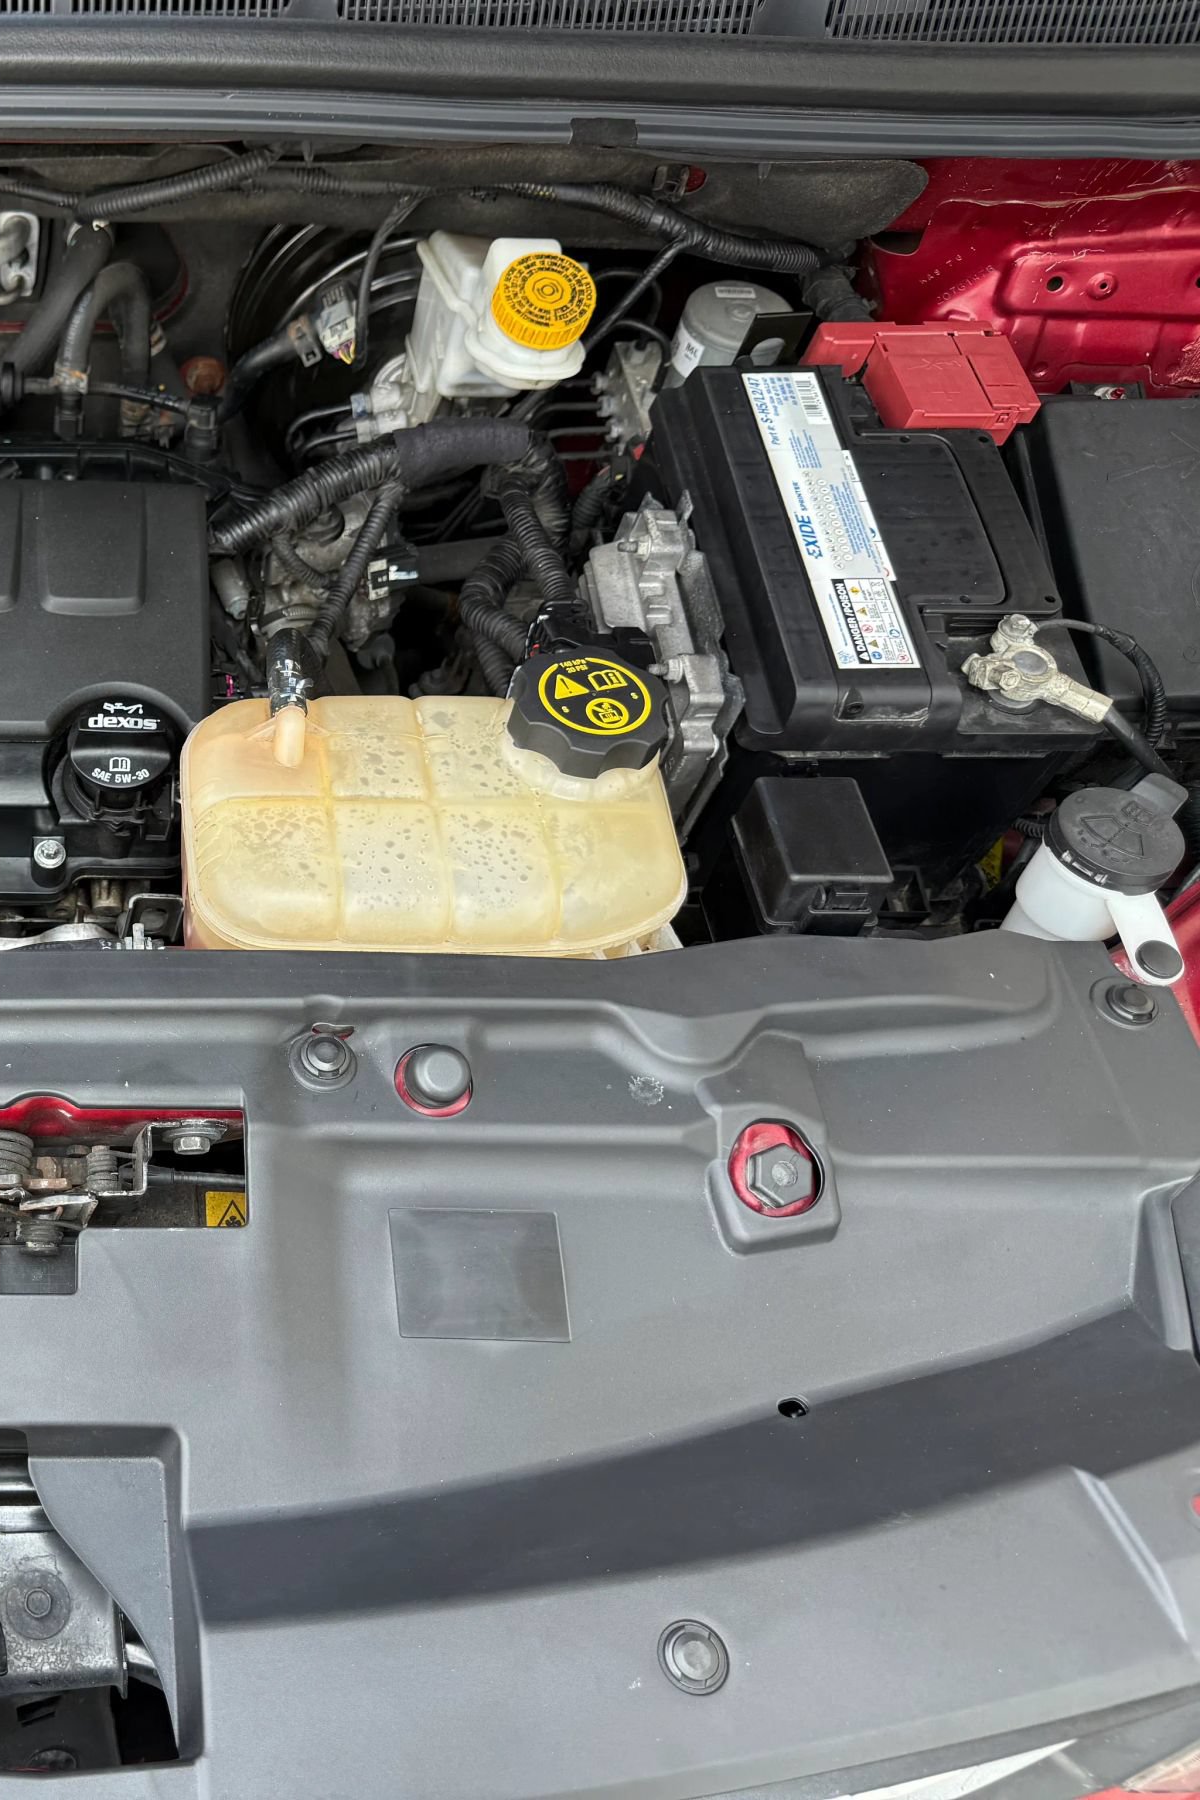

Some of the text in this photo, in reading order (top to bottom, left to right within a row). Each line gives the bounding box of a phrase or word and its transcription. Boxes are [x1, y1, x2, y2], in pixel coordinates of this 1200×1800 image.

[795, 514, 823, 559] EXIDE
[846, 617, 866, 652] DANGER
[88, 713, 157, 730] dexos
[92, 768, 150, 783] SAE 5W-30
